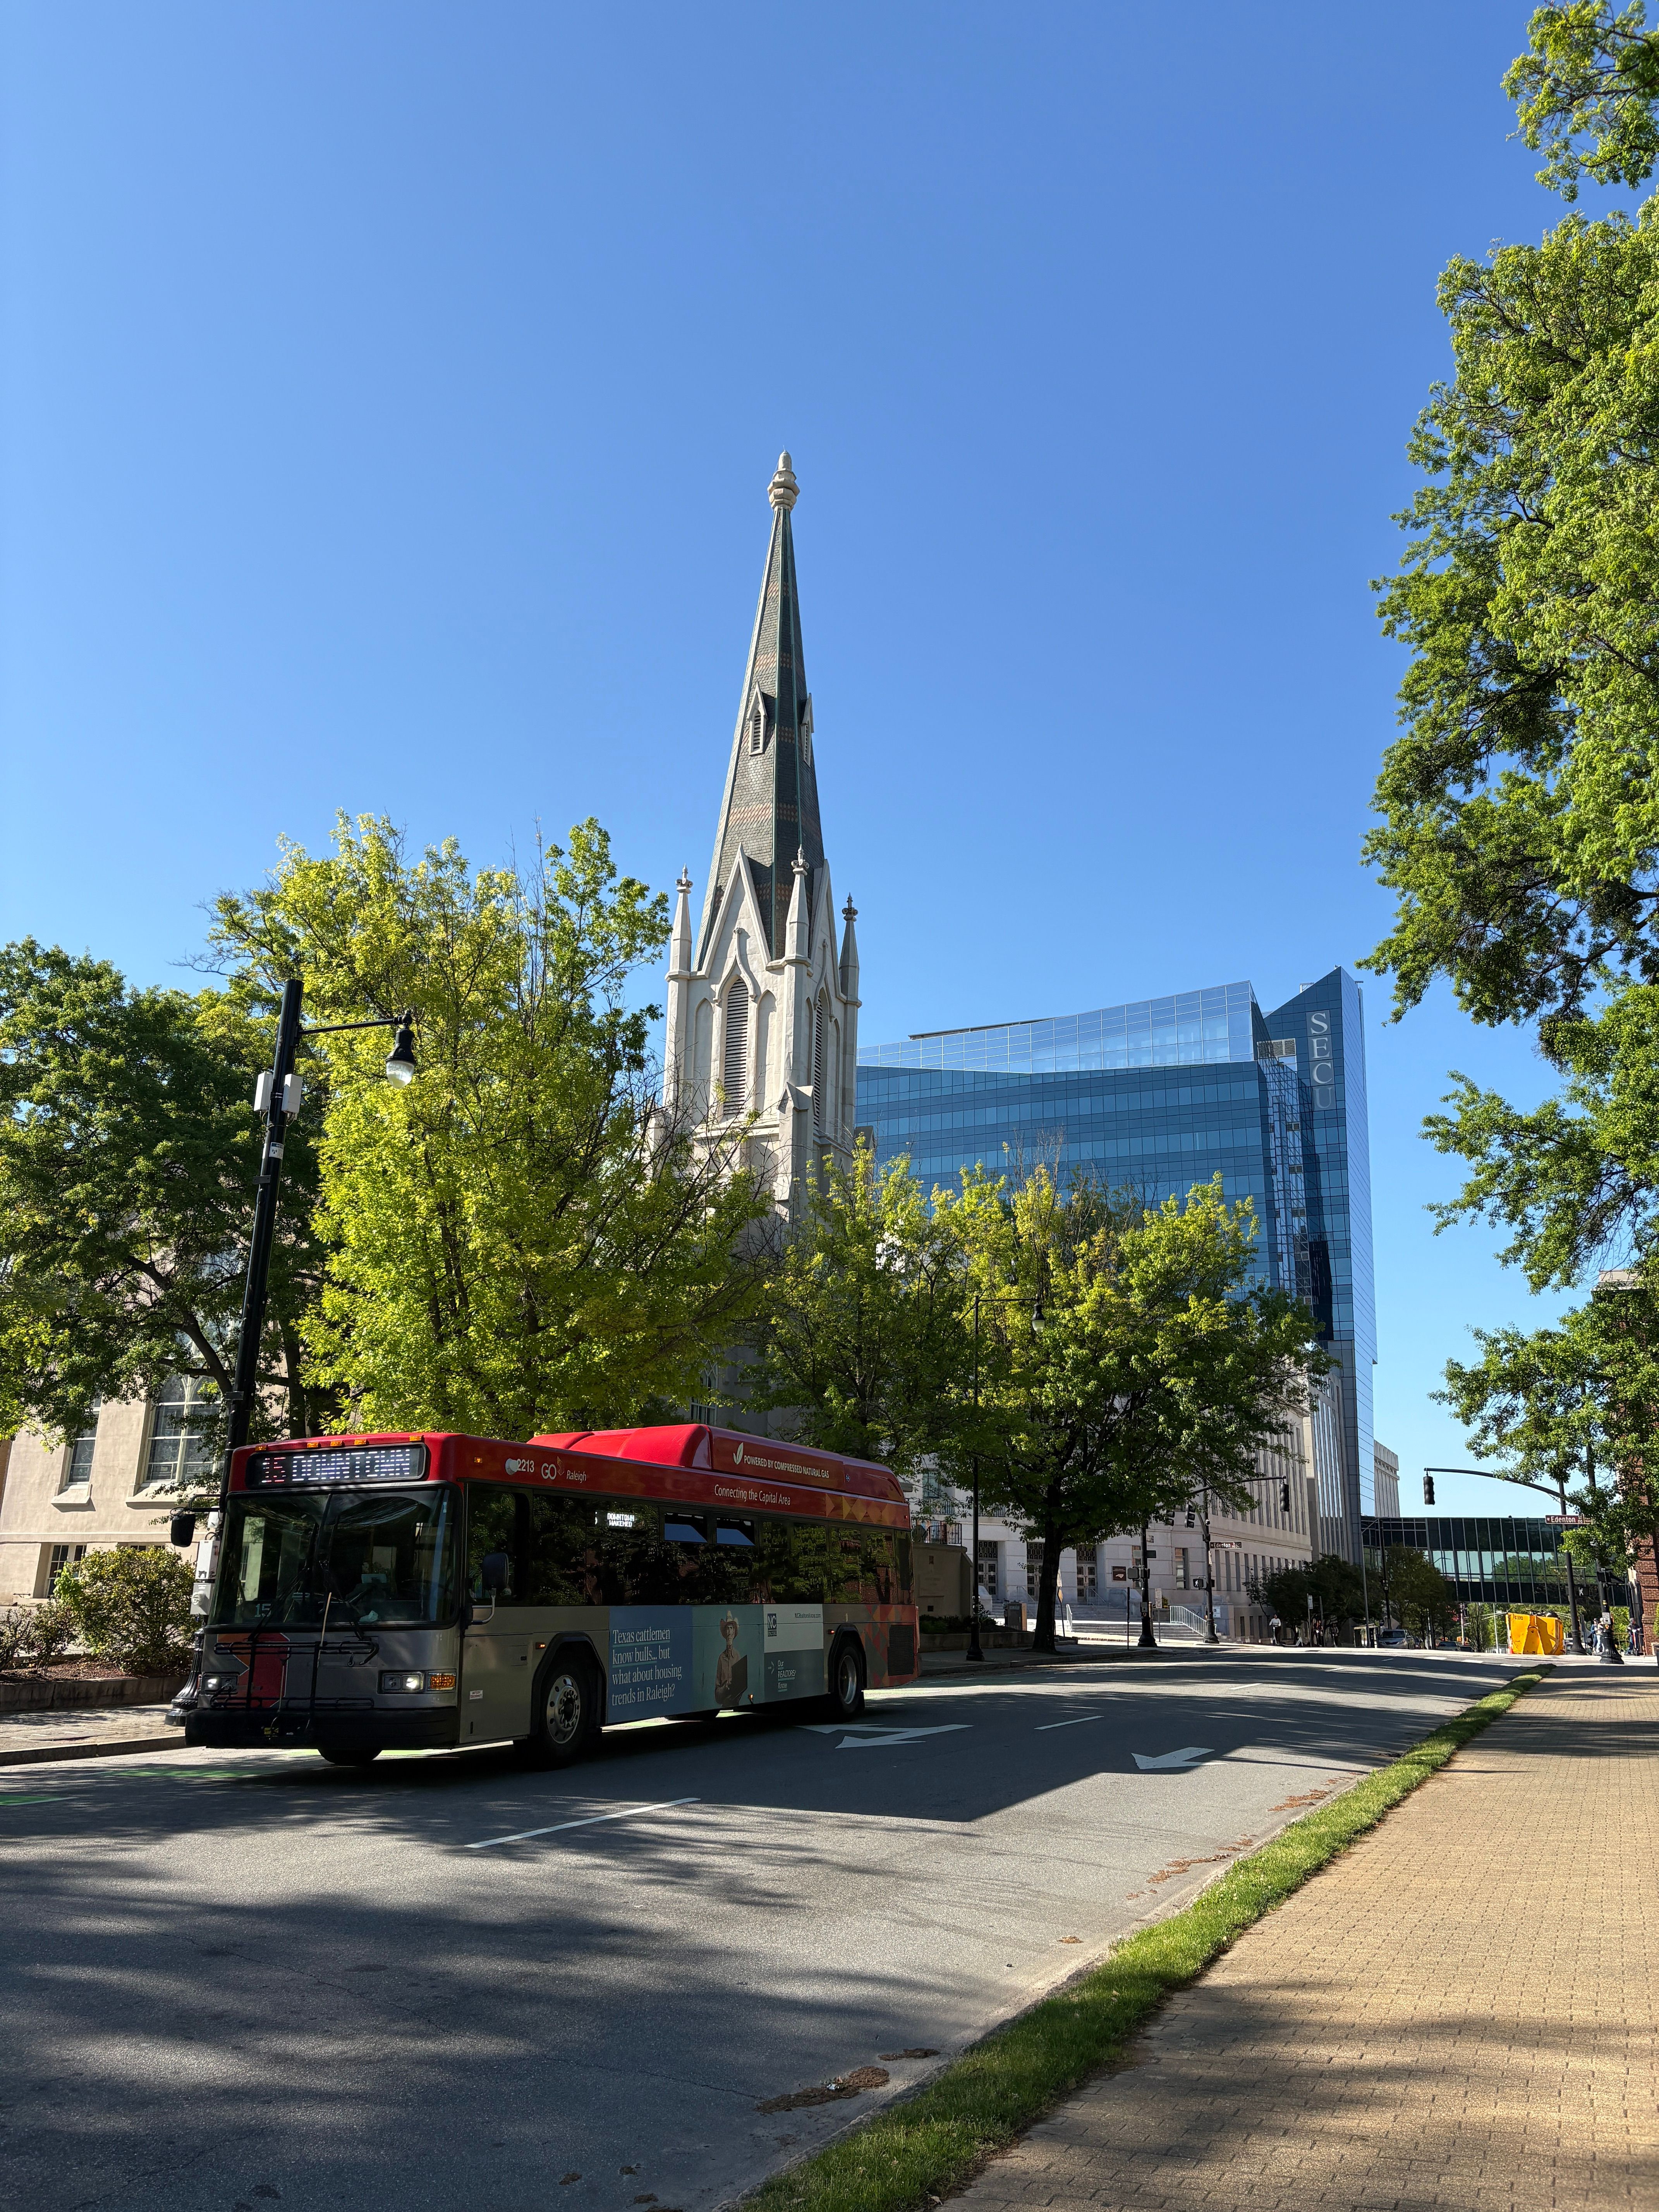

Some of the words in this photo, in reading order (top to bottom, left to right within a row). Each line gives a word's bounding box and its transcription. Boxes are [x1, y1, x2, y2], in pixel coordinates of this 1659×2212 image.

[1310, 1012, 1333, 1109] SECU
[262, 1457, 286, 1482] 15
[292, 1449, 410, 1481] DOWNTOWN
[517, 1458, 534, 1472] 2213
[541, 1463, 556, 1480] GO
[567, 1470, 587, 1483] Raleigh
[744, 1455, 767, 1467] POWERED
[768, 1459, 774, 1468] BY
[774, 1461, 802, 1474] COMPRESSED
[803, 1466, 821, 1477] NATURAL
[821, 1470, 829, 1478] GAS
[714, 1484, 747, 1502] Connecting
[749, 1488, 757, 1501] the
[759, 1491, 778, 1505] Capital
[778, 1494, 790, 1505] Area
[607, 1513, 635, 1522] DOWNTOWN
[768, 1615, 776, 1629] NC
[613, 1630, 634, 1644] Texas
[636, 1626, 670, 1642] cattlemen
[613, 1649, 633, 1664] know
[635, 1646, 657, 1662] bulls...
[659, 1645, 670, 1659] but
[612, 1669, 631, 1685] what
[632, 1667, 653, 1682] about
[655, 1664, 682, 1680] housing
[612, 1688, 635, 1706] trends
[637, 1688, 644, 1702] in
[646, 1683, 675, 1702] Raleigh?
